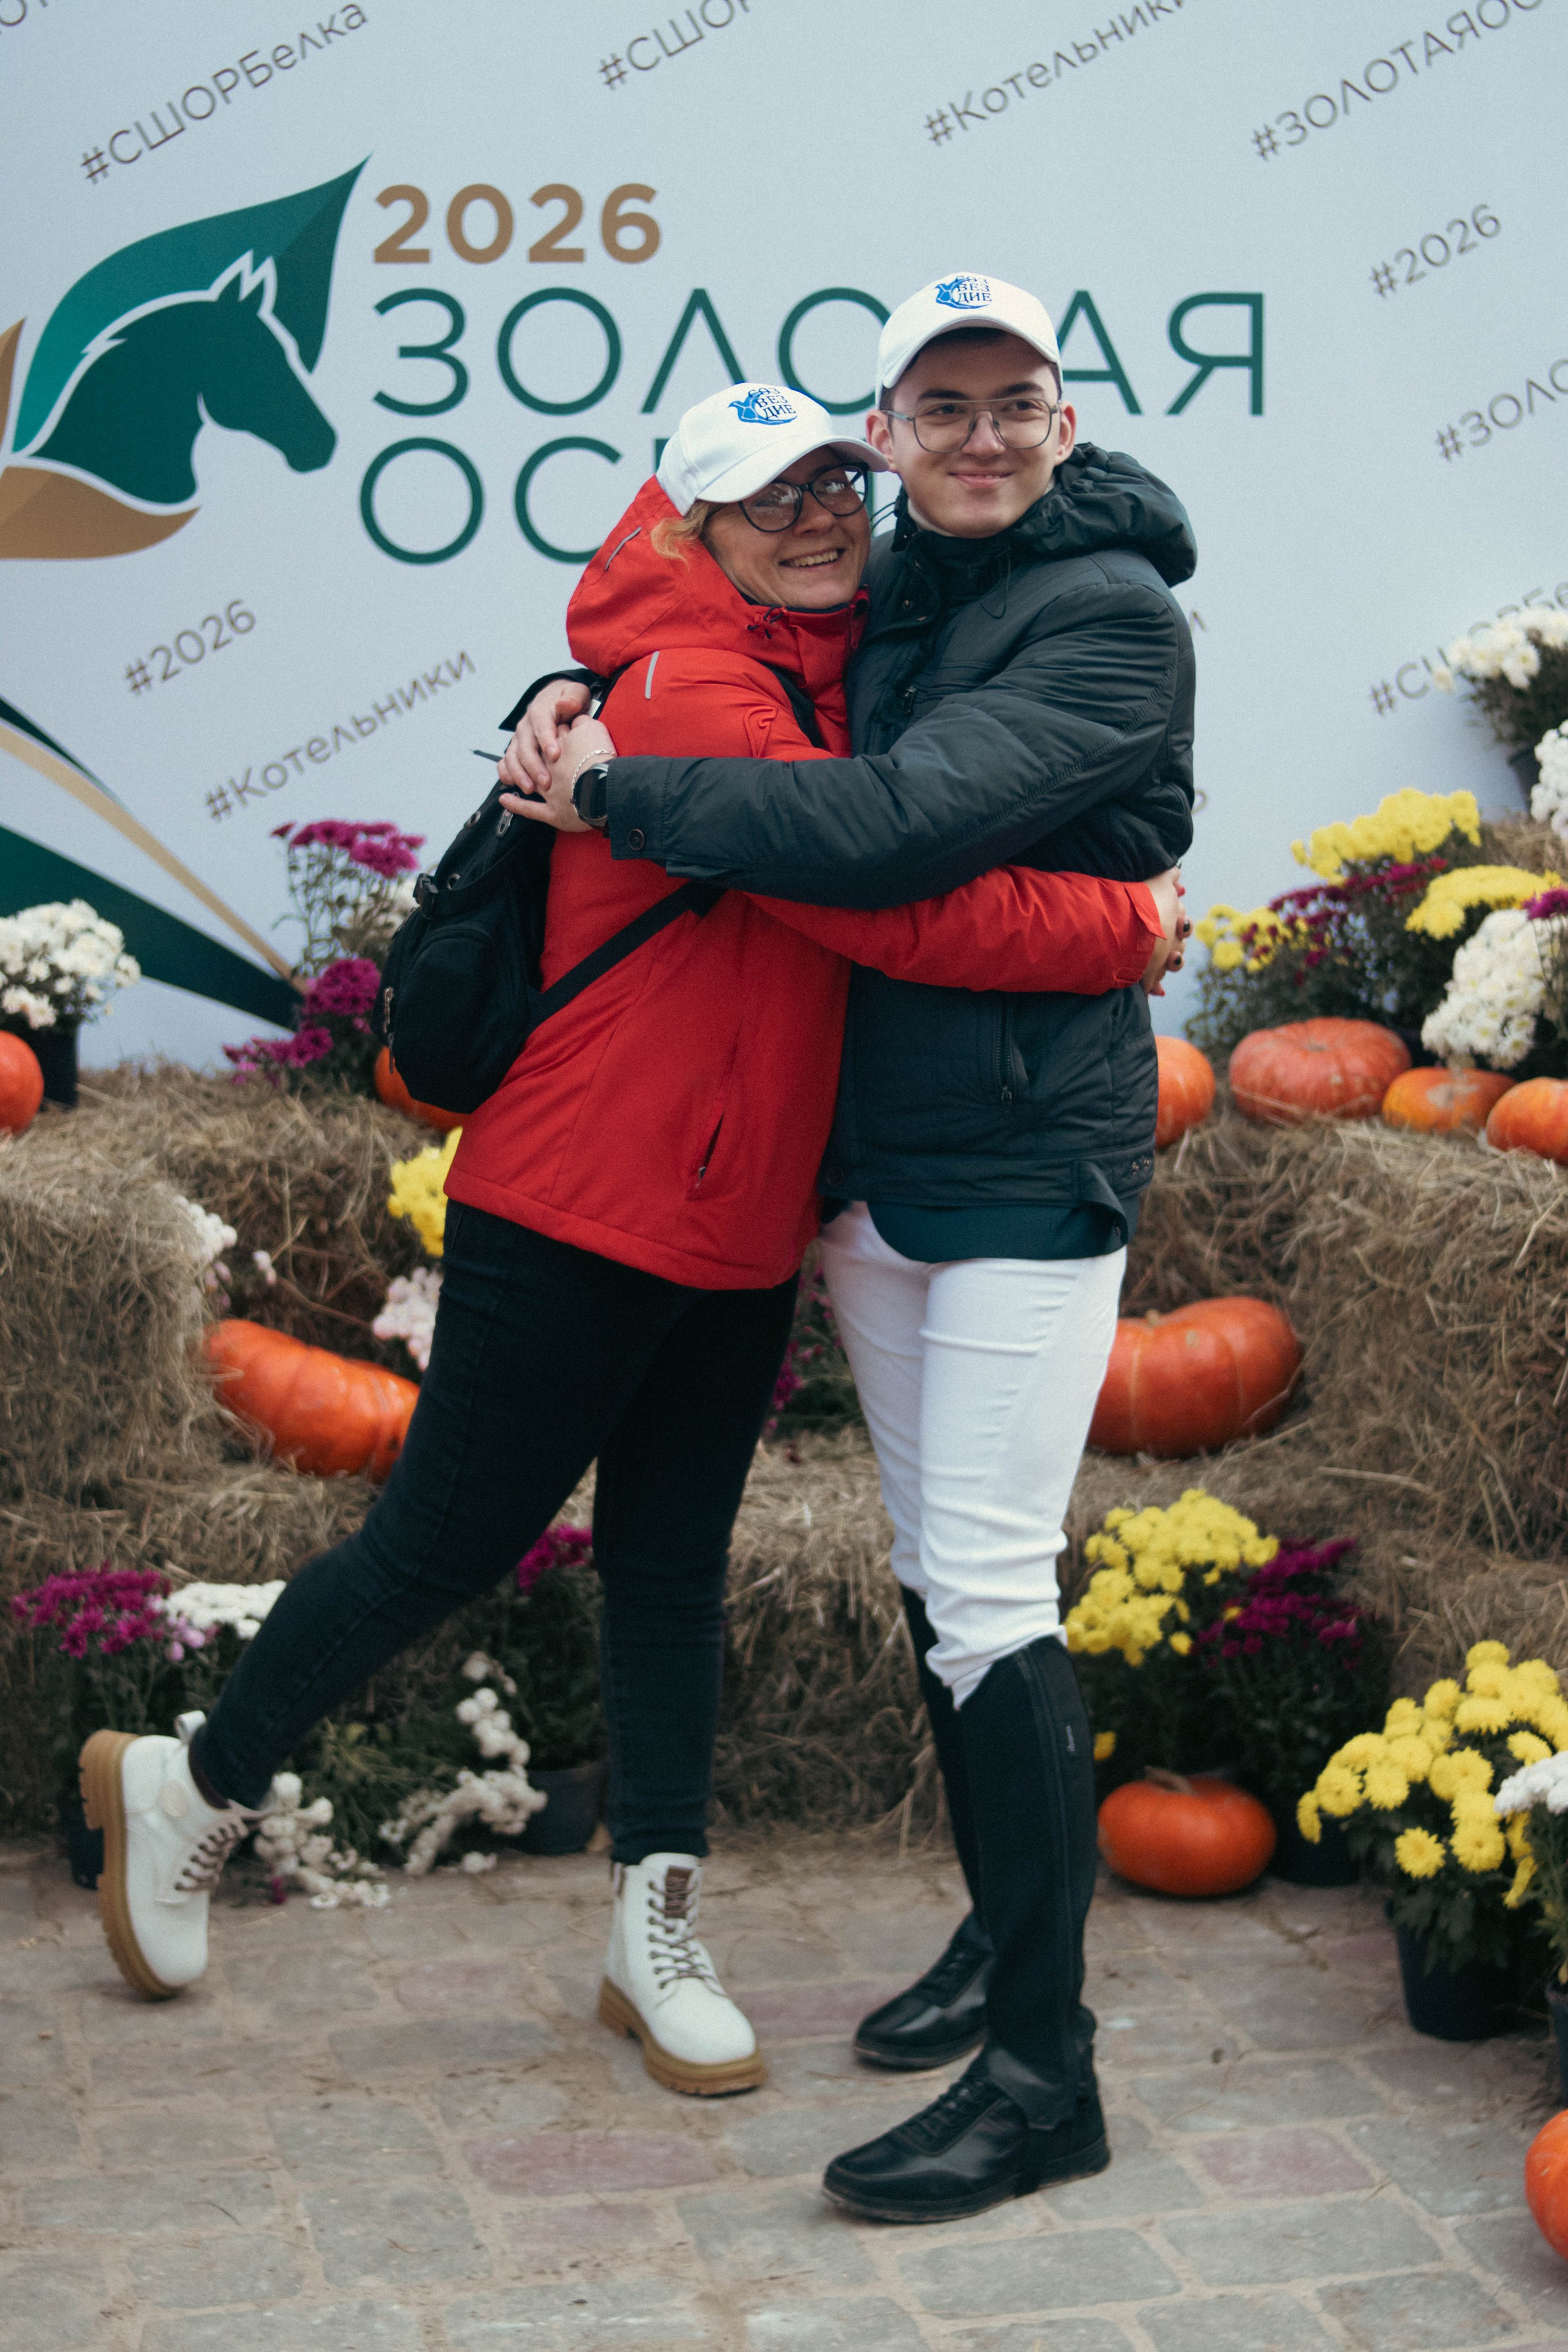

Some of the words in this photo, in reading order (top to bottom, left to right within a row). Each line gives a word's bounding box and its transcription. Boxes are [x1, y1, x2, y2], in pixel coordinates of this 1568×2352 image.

[598, 0, 750, 91] #СШО
[924, 0, 1183, 146] #Котельник
[80, 2, 368, 184] #СШОРБелка
[372, 183, 662, 265] 2026
[1370, 203, 1501, 299] #2026
[957, 283, 990, 292] ВЕЗ
[957, 292, 992, 303] ДИЕ
[372, 287, 1264, 417] ЗОЛОАЯ
[755, 395, 788, 408] ВЕЗ
[763, 404, 797, 420] ДИЕ
[124, 599, 256, 697] #2026
[205, 650, 477, 822] #Котельники
